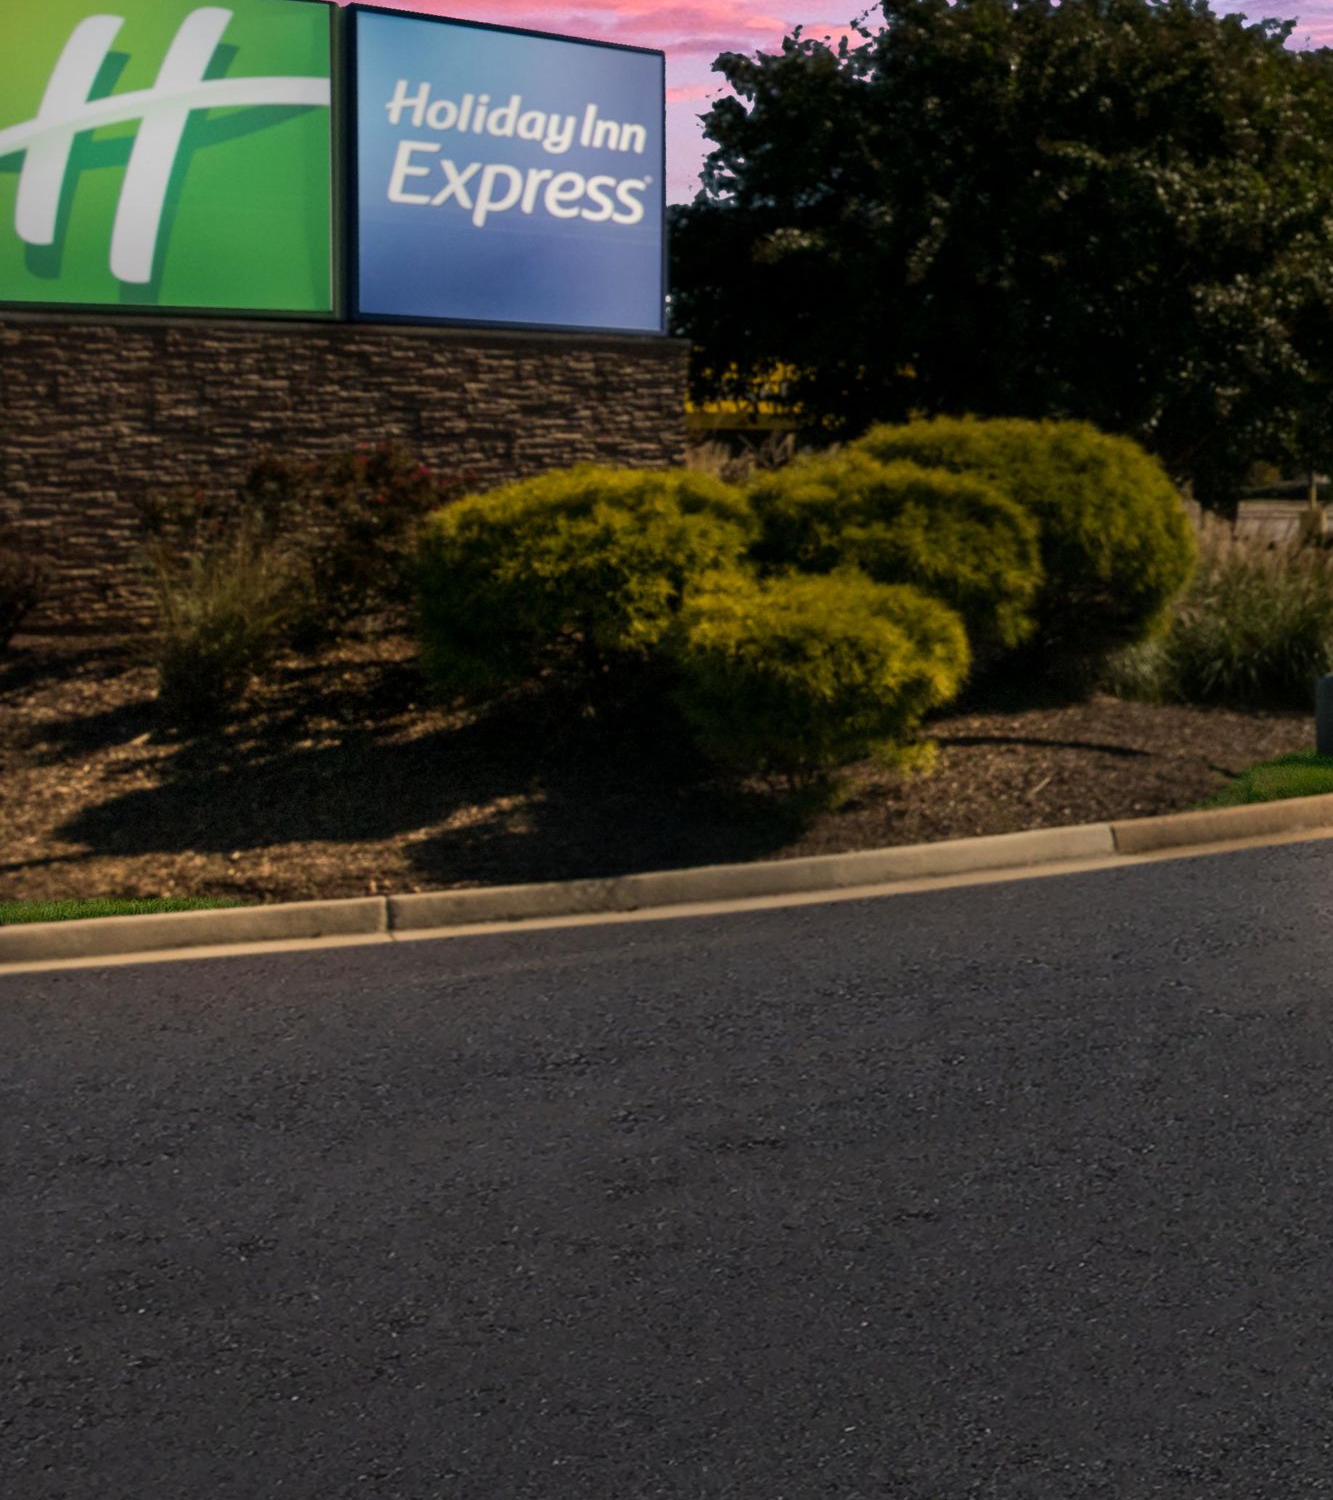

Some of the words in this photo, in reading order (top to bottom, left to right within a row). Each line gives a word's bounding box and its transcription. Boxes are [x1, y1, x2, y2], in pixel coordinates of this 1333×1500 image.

[384, 79, 578, 155] Holiday
[579, 102, 647, 155] Inn
[387, 139, 646, 227] Express
